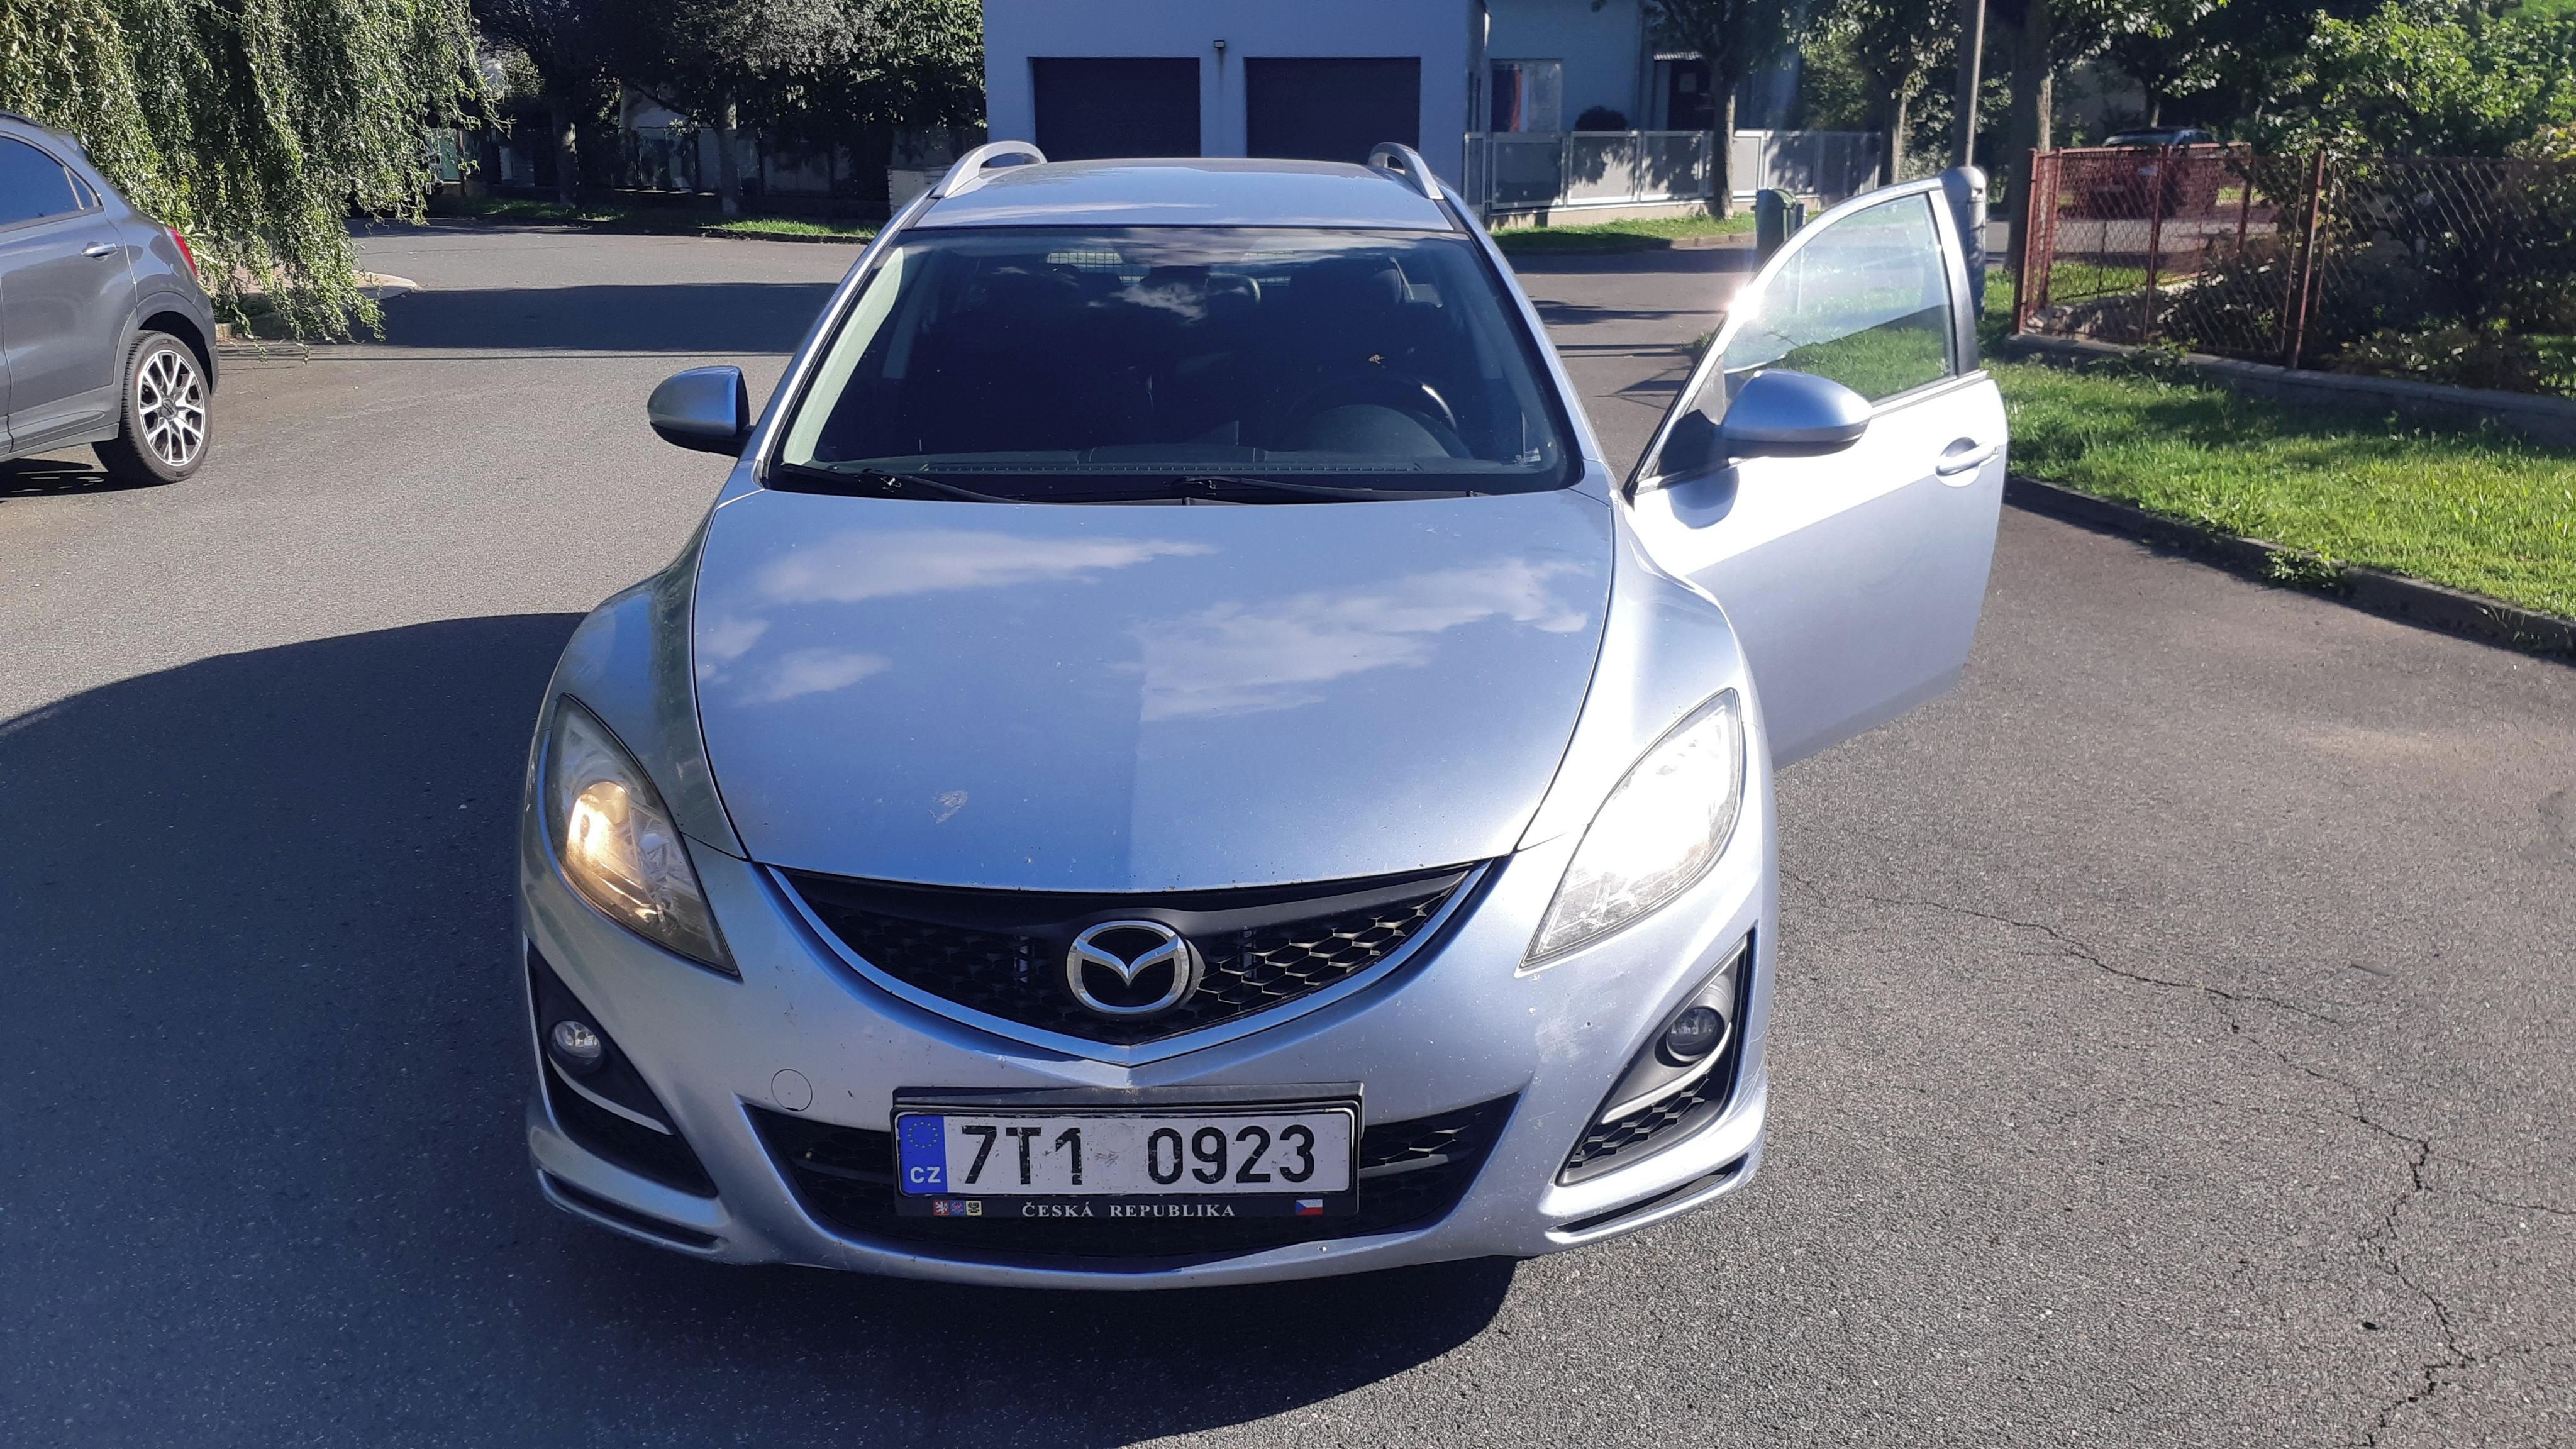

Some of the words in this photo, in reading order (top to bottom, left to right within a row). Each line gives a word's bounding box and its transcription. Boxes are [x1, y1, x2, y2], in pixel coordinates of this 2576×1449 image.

[962, 1124, 1083, 1185] 7T1
[1146, 1124, 1315, 1185] 0923
[910, 1166, 941, 1184] CZ
[1021, 1201, 1094, 1218] ČESKÁ
[1109, 1204, 1236, 1218] REPUBLIKA
